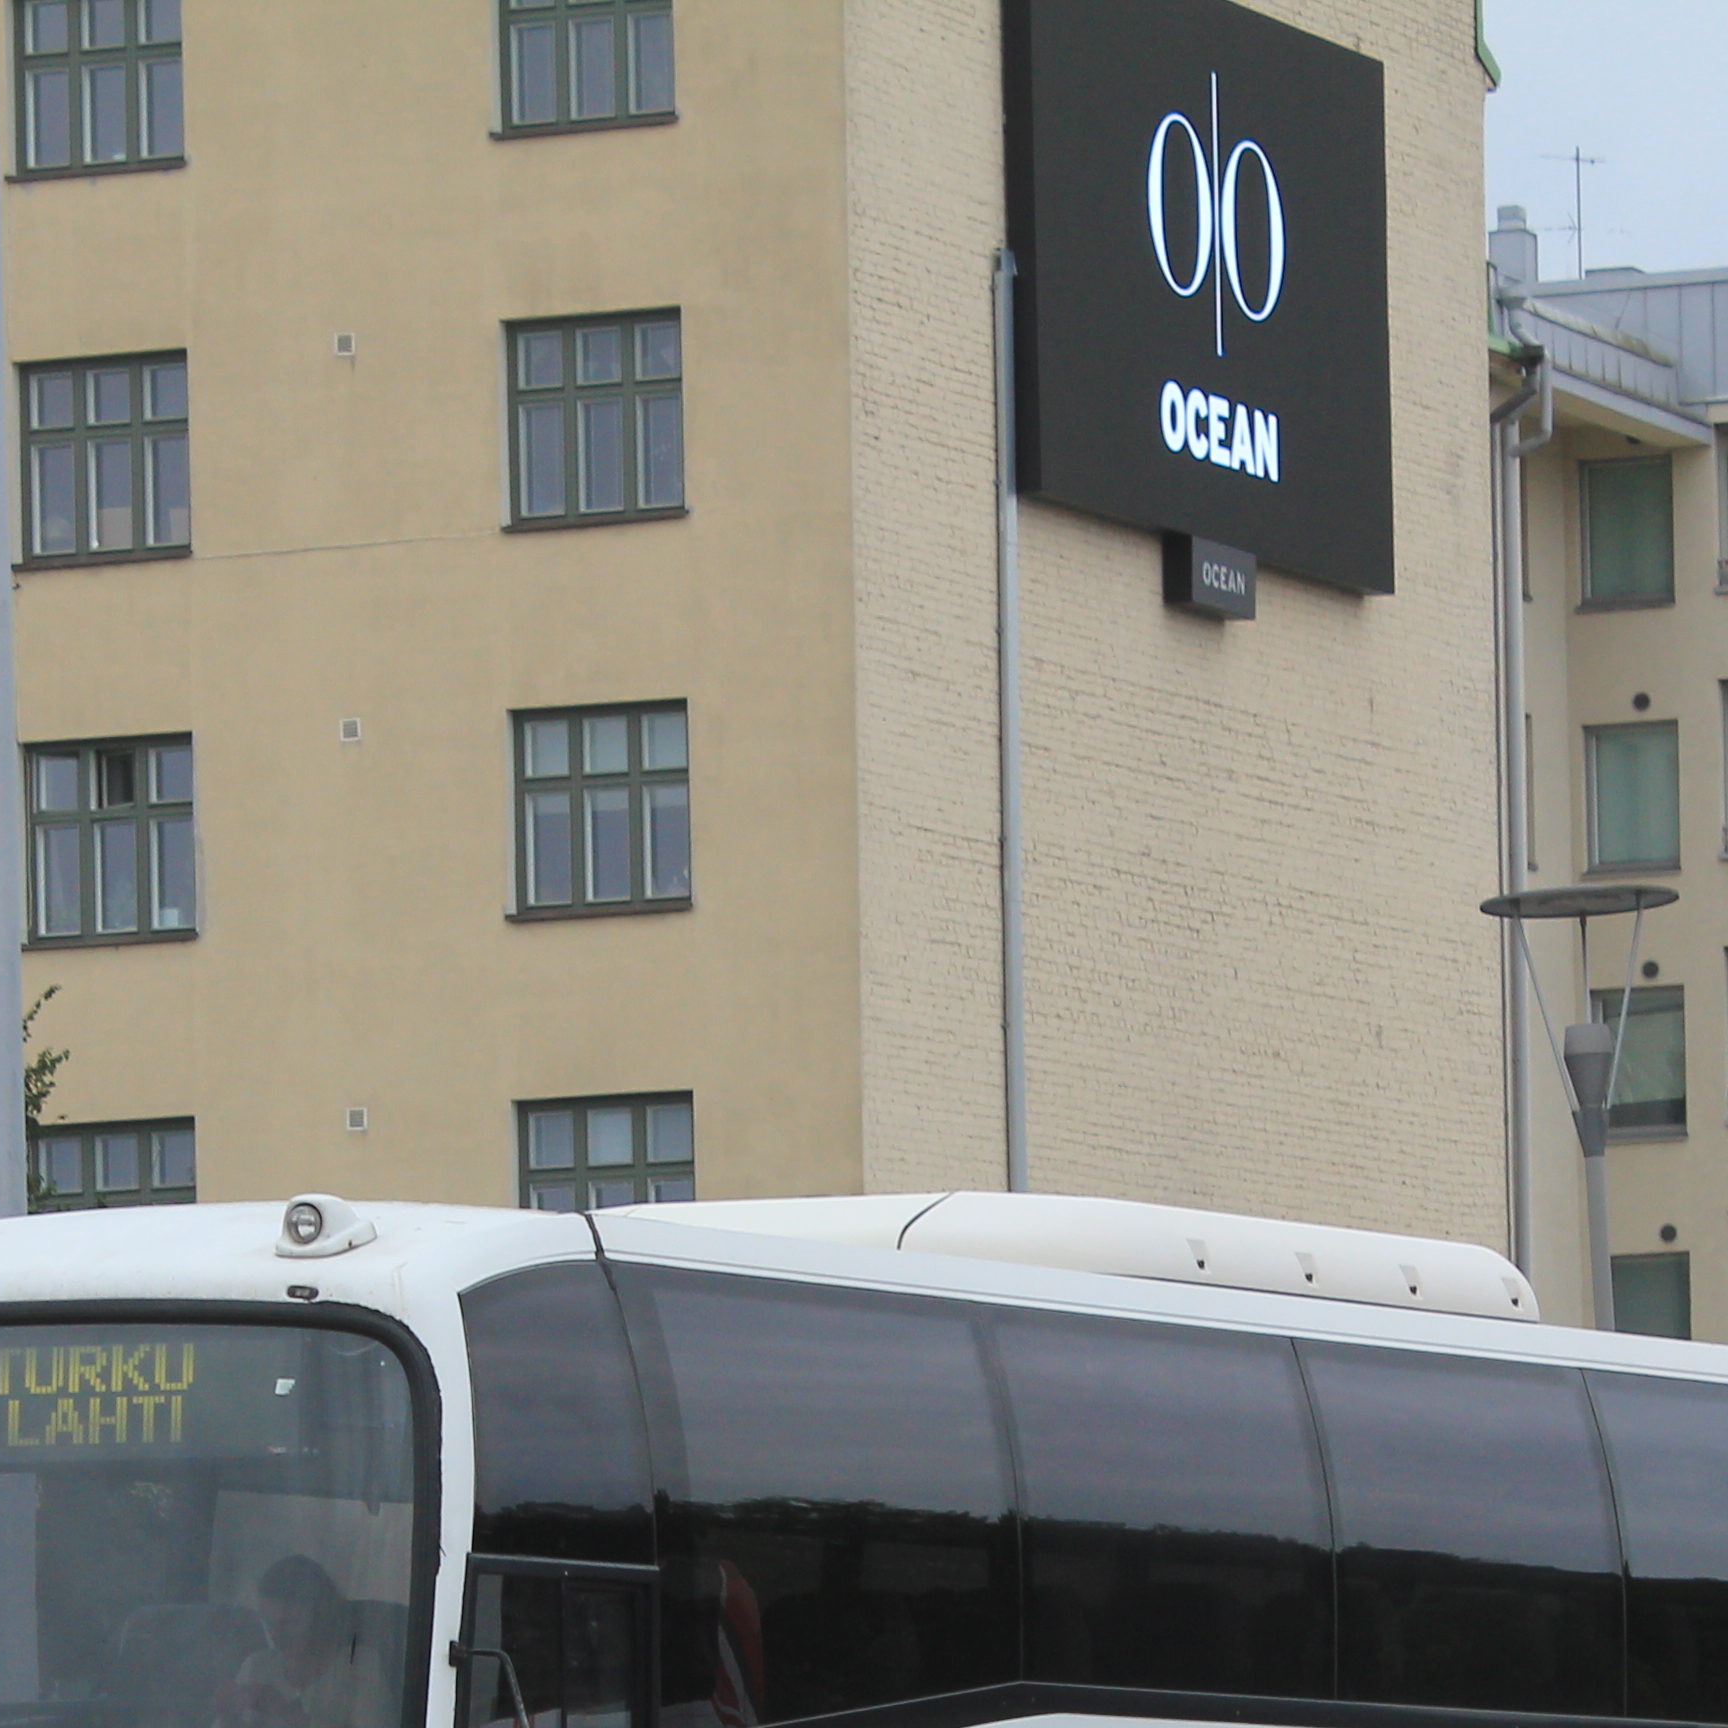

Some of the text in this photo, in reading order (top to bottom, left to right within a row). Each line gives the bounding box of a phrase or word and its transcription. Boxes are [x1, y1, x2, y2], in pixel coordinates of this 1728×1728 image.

[1159, 378, 1280, 483] OCEAN
[1202, 561, 1246, 596] OCEAN
[7, 1395, 183, 1447] LAHTI
